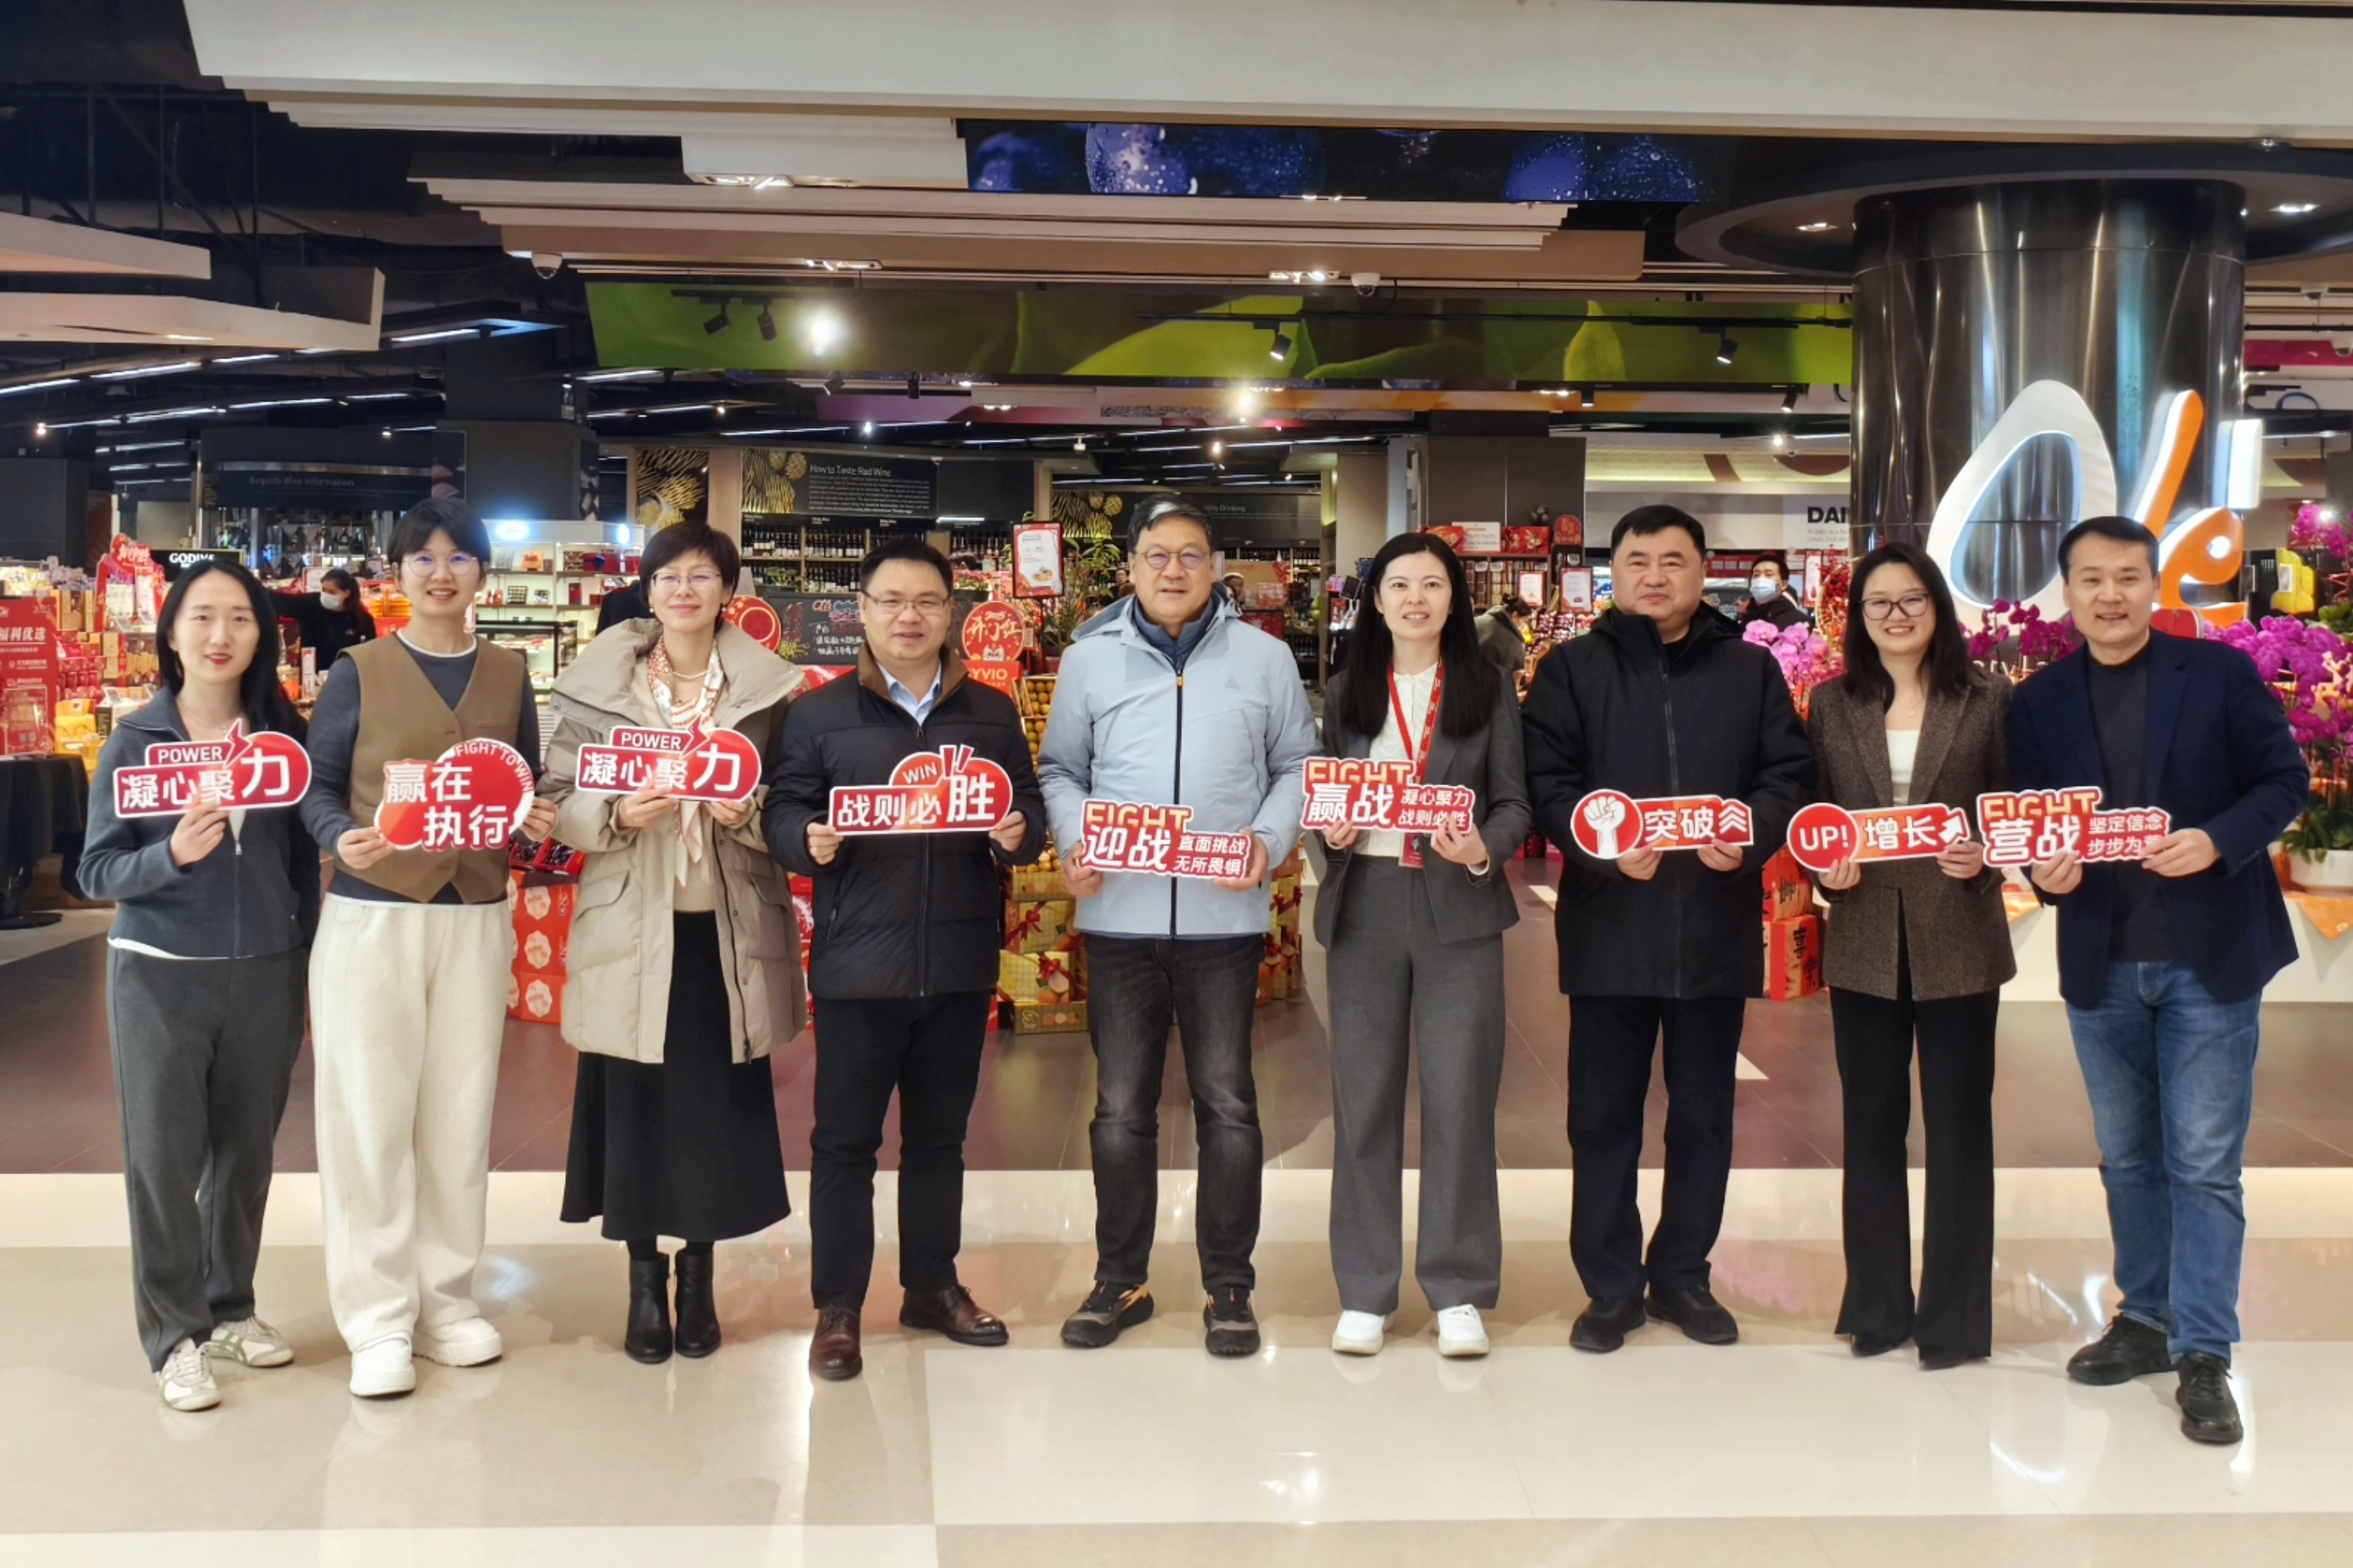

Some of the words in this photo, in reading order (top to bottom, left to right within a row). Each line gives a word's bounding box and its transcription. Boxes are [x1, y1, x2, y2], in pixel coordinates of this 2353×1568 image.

[1807, 506, 1850, 524] DAI
[968, 667, 1008, 680] YVIO
[157, 746, 223, 764] POWER
[621, 733, 682, 750] POWER
[121, 748, 291, 809] 凝心聚力
[455, 742, 499, 757] FIGHT
[499, 746, 517, 766] TO
[514, 760, 535, 792] WIN
[582, 744, 740, 792] 凝心聚力
[902, 762, 938, 783] WIN
[1308, 761, 1411, 784] FIGHT
[385, 762, 473, 804] 赢在
[1400, 788, 1469, 806] 凝心聚力
[837, 773, 996, 827] 战则必胜
[1307, 782, 1394, 824] 赢战
[1984, 792, 2098, 820] FIGHT
[423, 805, 509, 848] 执行
[1086, 803, 1189, 831] FIGHT
[1397, 809, 1468, 827] 战则必胜
[1644, 806, 1715, 843] 突破
[2088, 813, 2164, 834] 坚定信念
[1177, 834, 1246, 856] 直面挑战
[1799, 822, 1850, 852] UP!
[1865, 816, 1938, 849] 增长
[1989, 814, 2081, 861] 营战
[1082, 824, 1171, 871] 迎战
[1173, 856, 1242, 875] 无所畏惧
